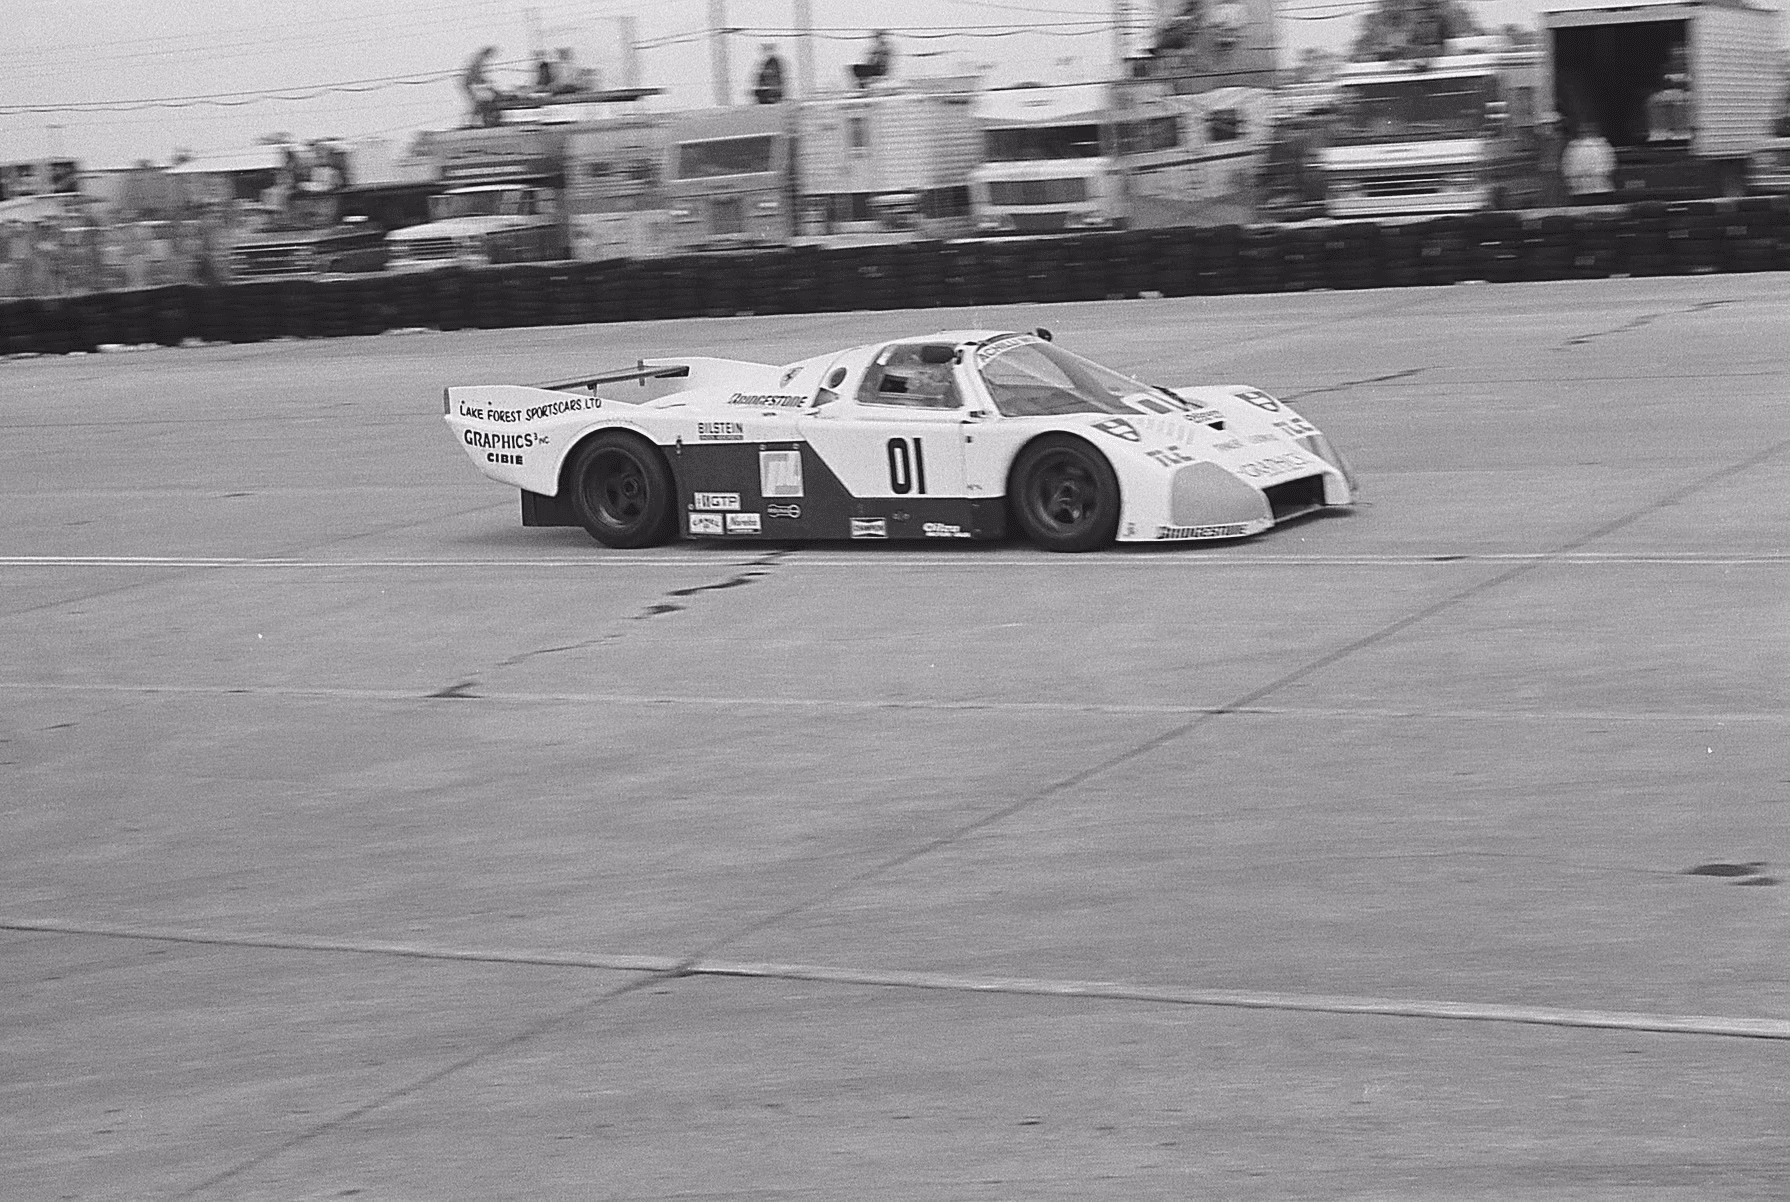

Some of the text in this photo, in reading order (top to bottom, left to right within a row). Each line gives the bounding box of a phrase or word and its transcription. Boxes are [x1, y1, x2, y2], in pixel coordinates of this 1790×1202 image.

[460, 398, 602, 423] LAKE FOREST SPORTSCARS LTD
[698, 422, 744, 434] BILSTEIN
[464, 429, 533, 449] GRAPHICS
[487, 452, 524, 465] CIBIE
[887, 437, 926, 495] 01
[712, 496, 738, 507] GTP
